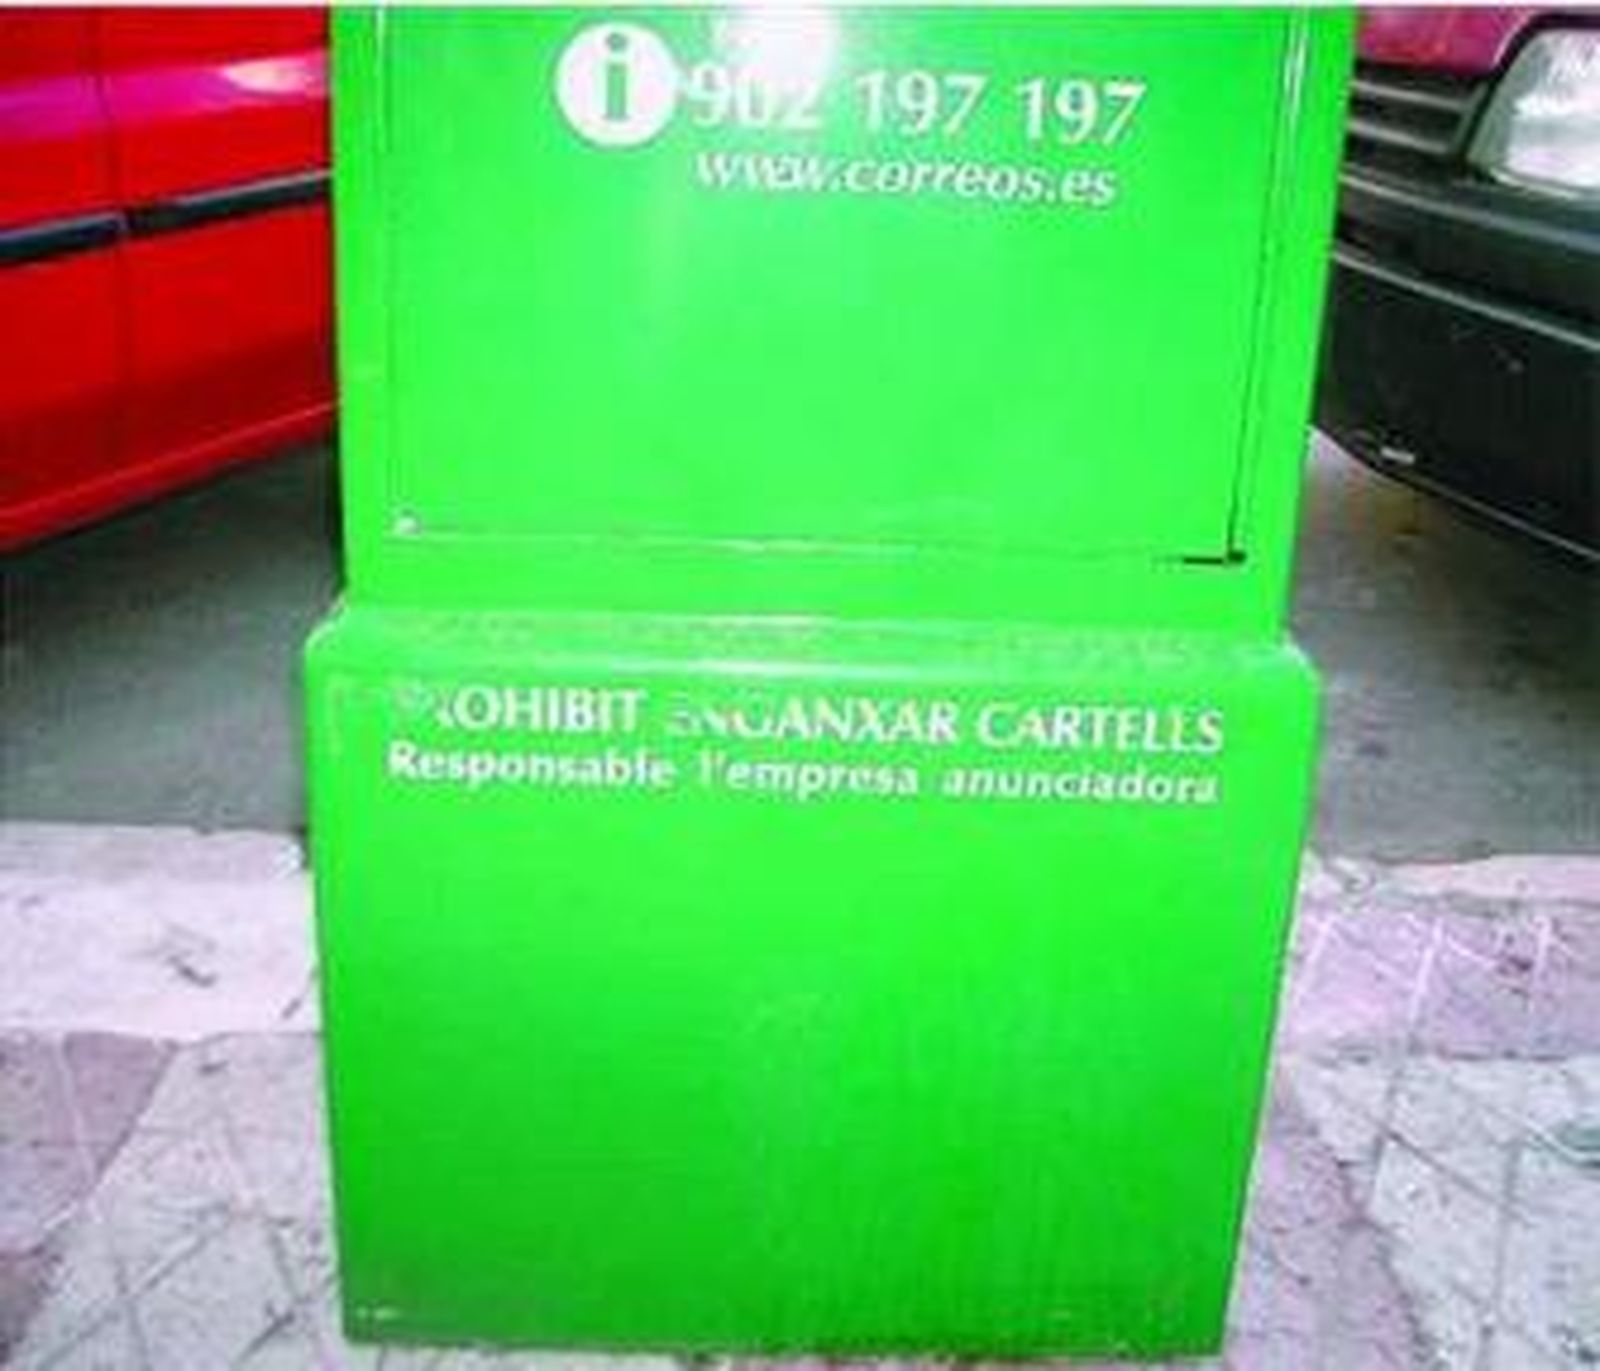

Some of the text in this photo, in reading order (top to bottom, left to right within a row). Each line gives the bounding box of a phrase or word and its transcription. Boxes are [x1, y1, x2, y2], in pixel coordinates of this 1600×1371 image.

[688, 62, 824, 131] 902
[857, 71, 988, 137] 197
[1016, 79, 1147, 147] 197
[697, 151, 1119, 207] www.correos.es
[977, 701, 1224, 754] CARTELLS
[388, 741, 675, 788] Responsable
[942, 766, 1220, 803] anunciadora
